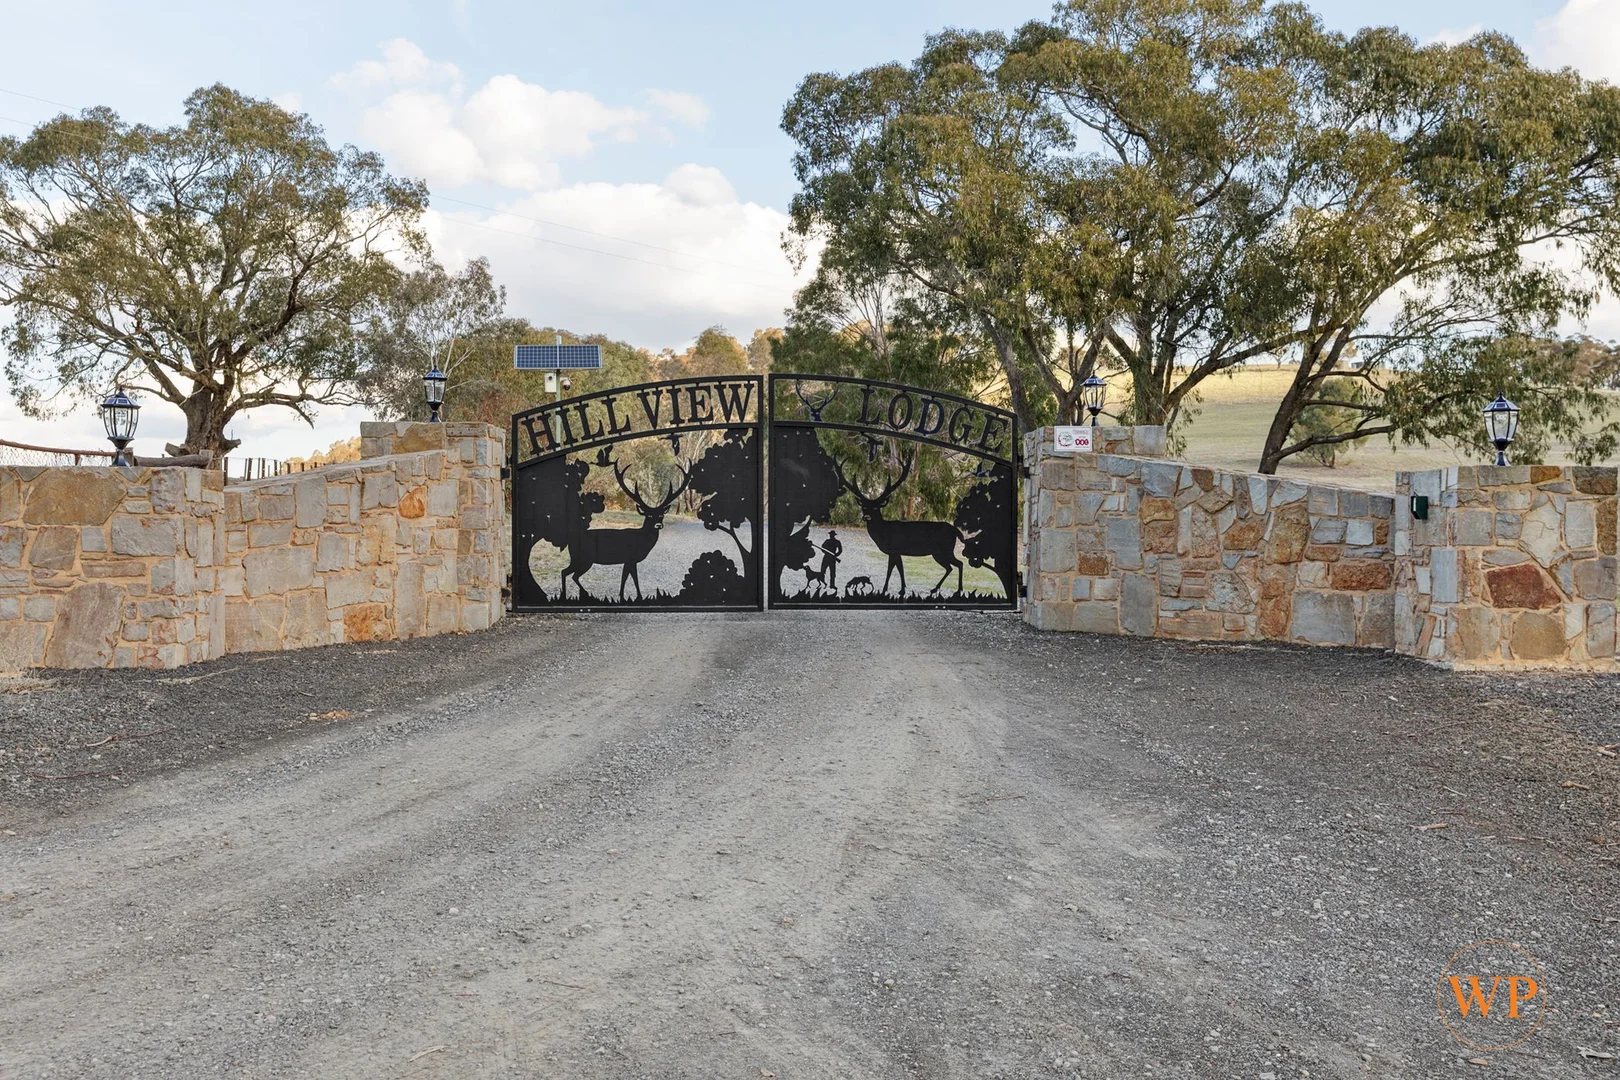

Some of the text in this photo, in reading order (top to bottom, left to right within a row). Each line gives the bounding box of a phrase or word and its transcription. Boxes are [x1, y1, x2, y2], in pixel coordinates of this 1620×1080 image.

[521, 383, 1008, 454] HILL VIEW LODGE
